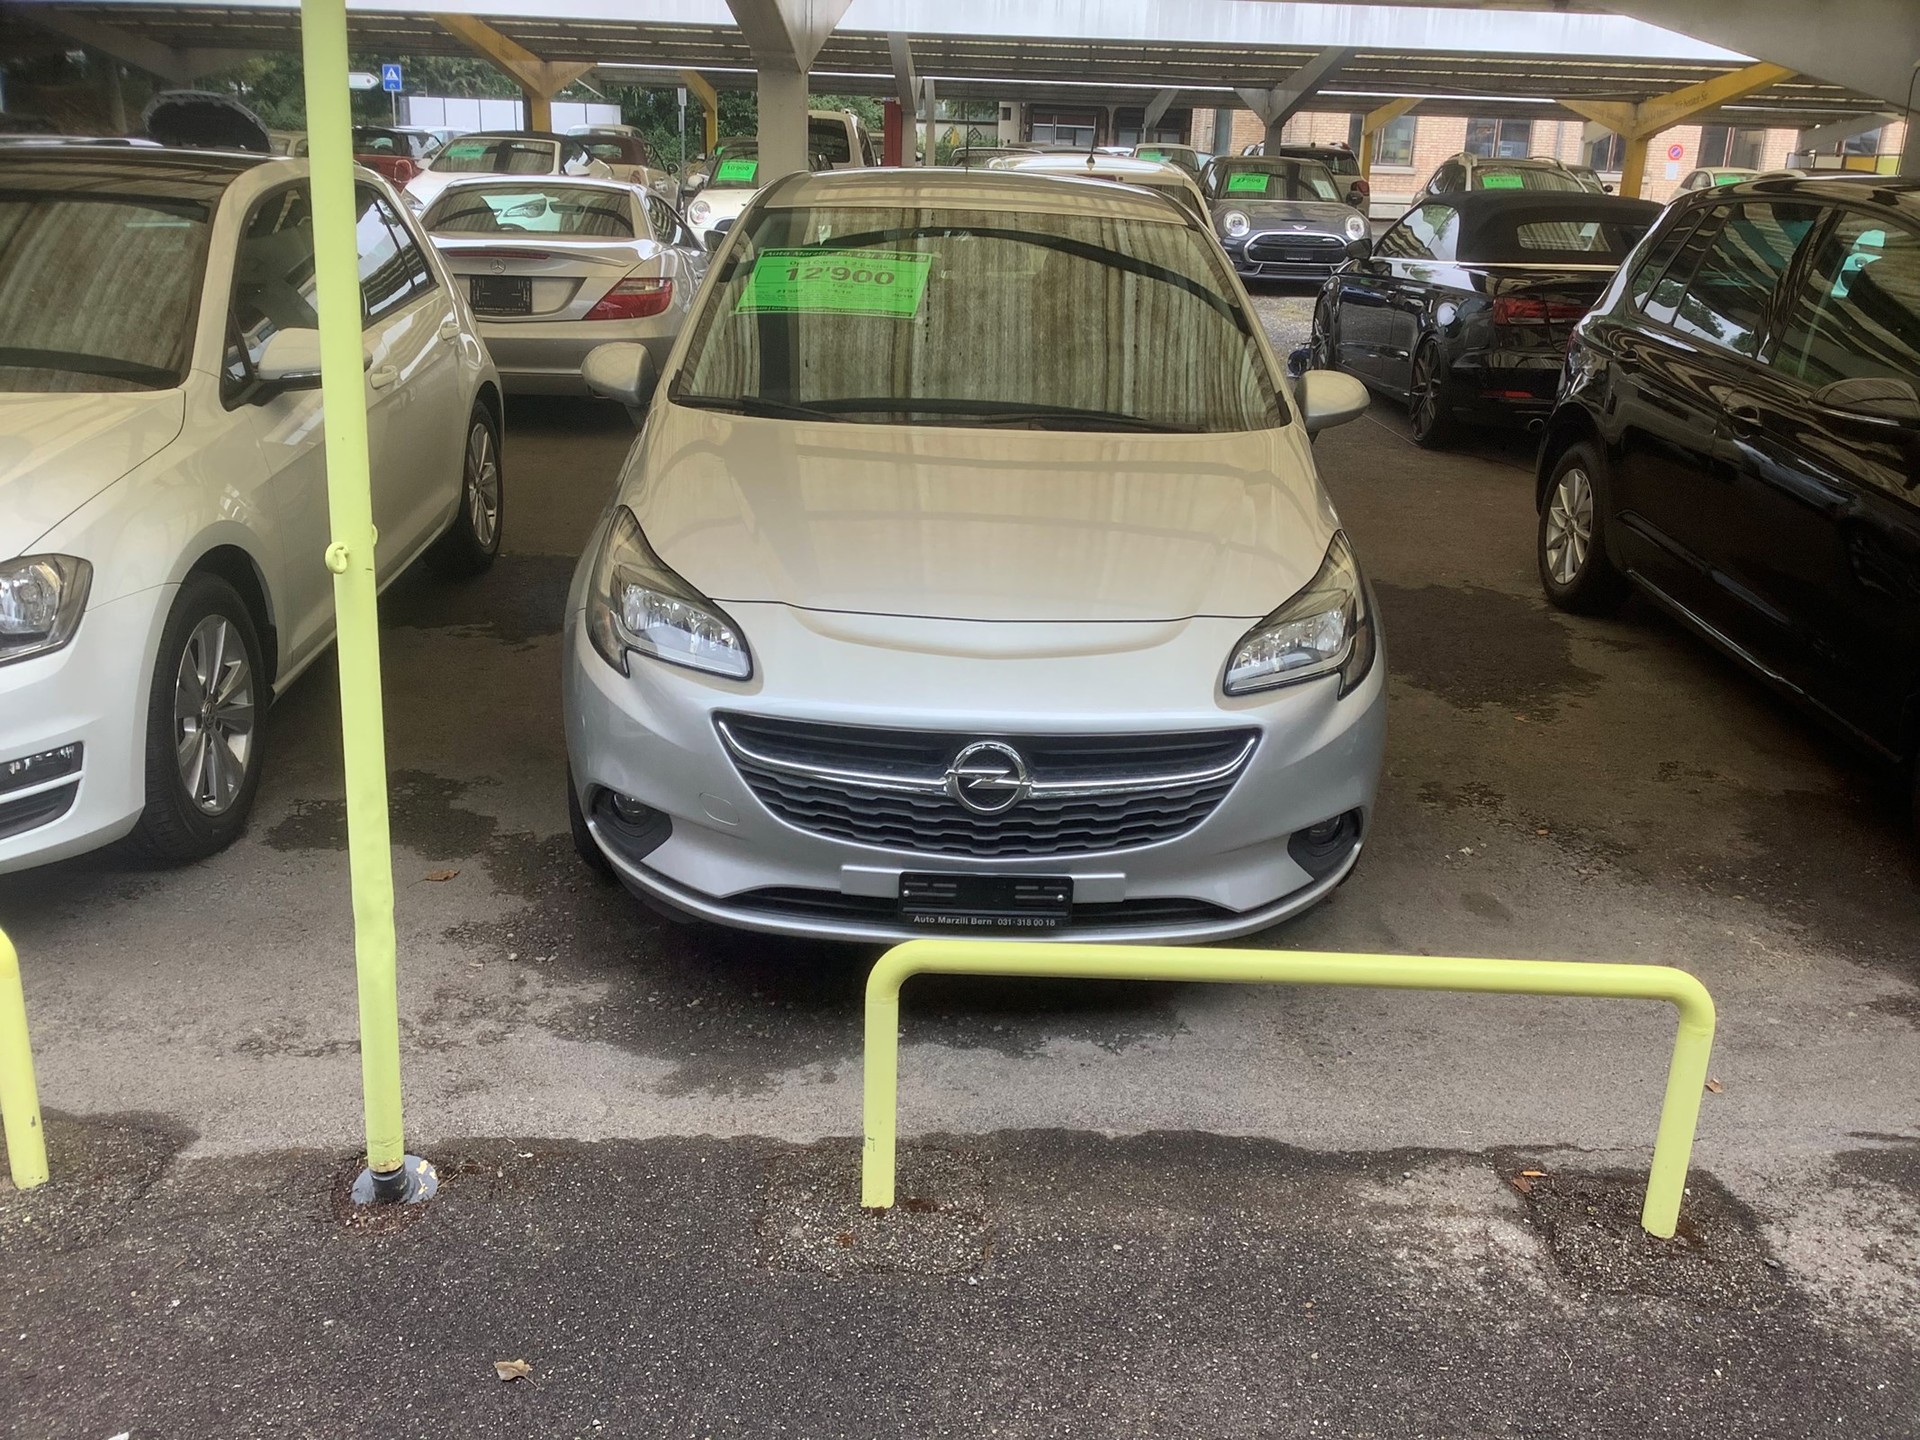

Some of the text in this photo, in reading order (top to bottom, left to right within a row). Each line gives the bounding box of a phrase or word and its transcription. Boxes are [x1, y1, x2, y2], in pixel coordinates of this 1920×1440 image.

[786, 266, 895, 285] 12'900
[914, 915, 936, 924] Auto
[971, 917, 993, 926] Bern
[1033, 918, 1044, 927] 00
[1046, 918, 1056, 927] 18
